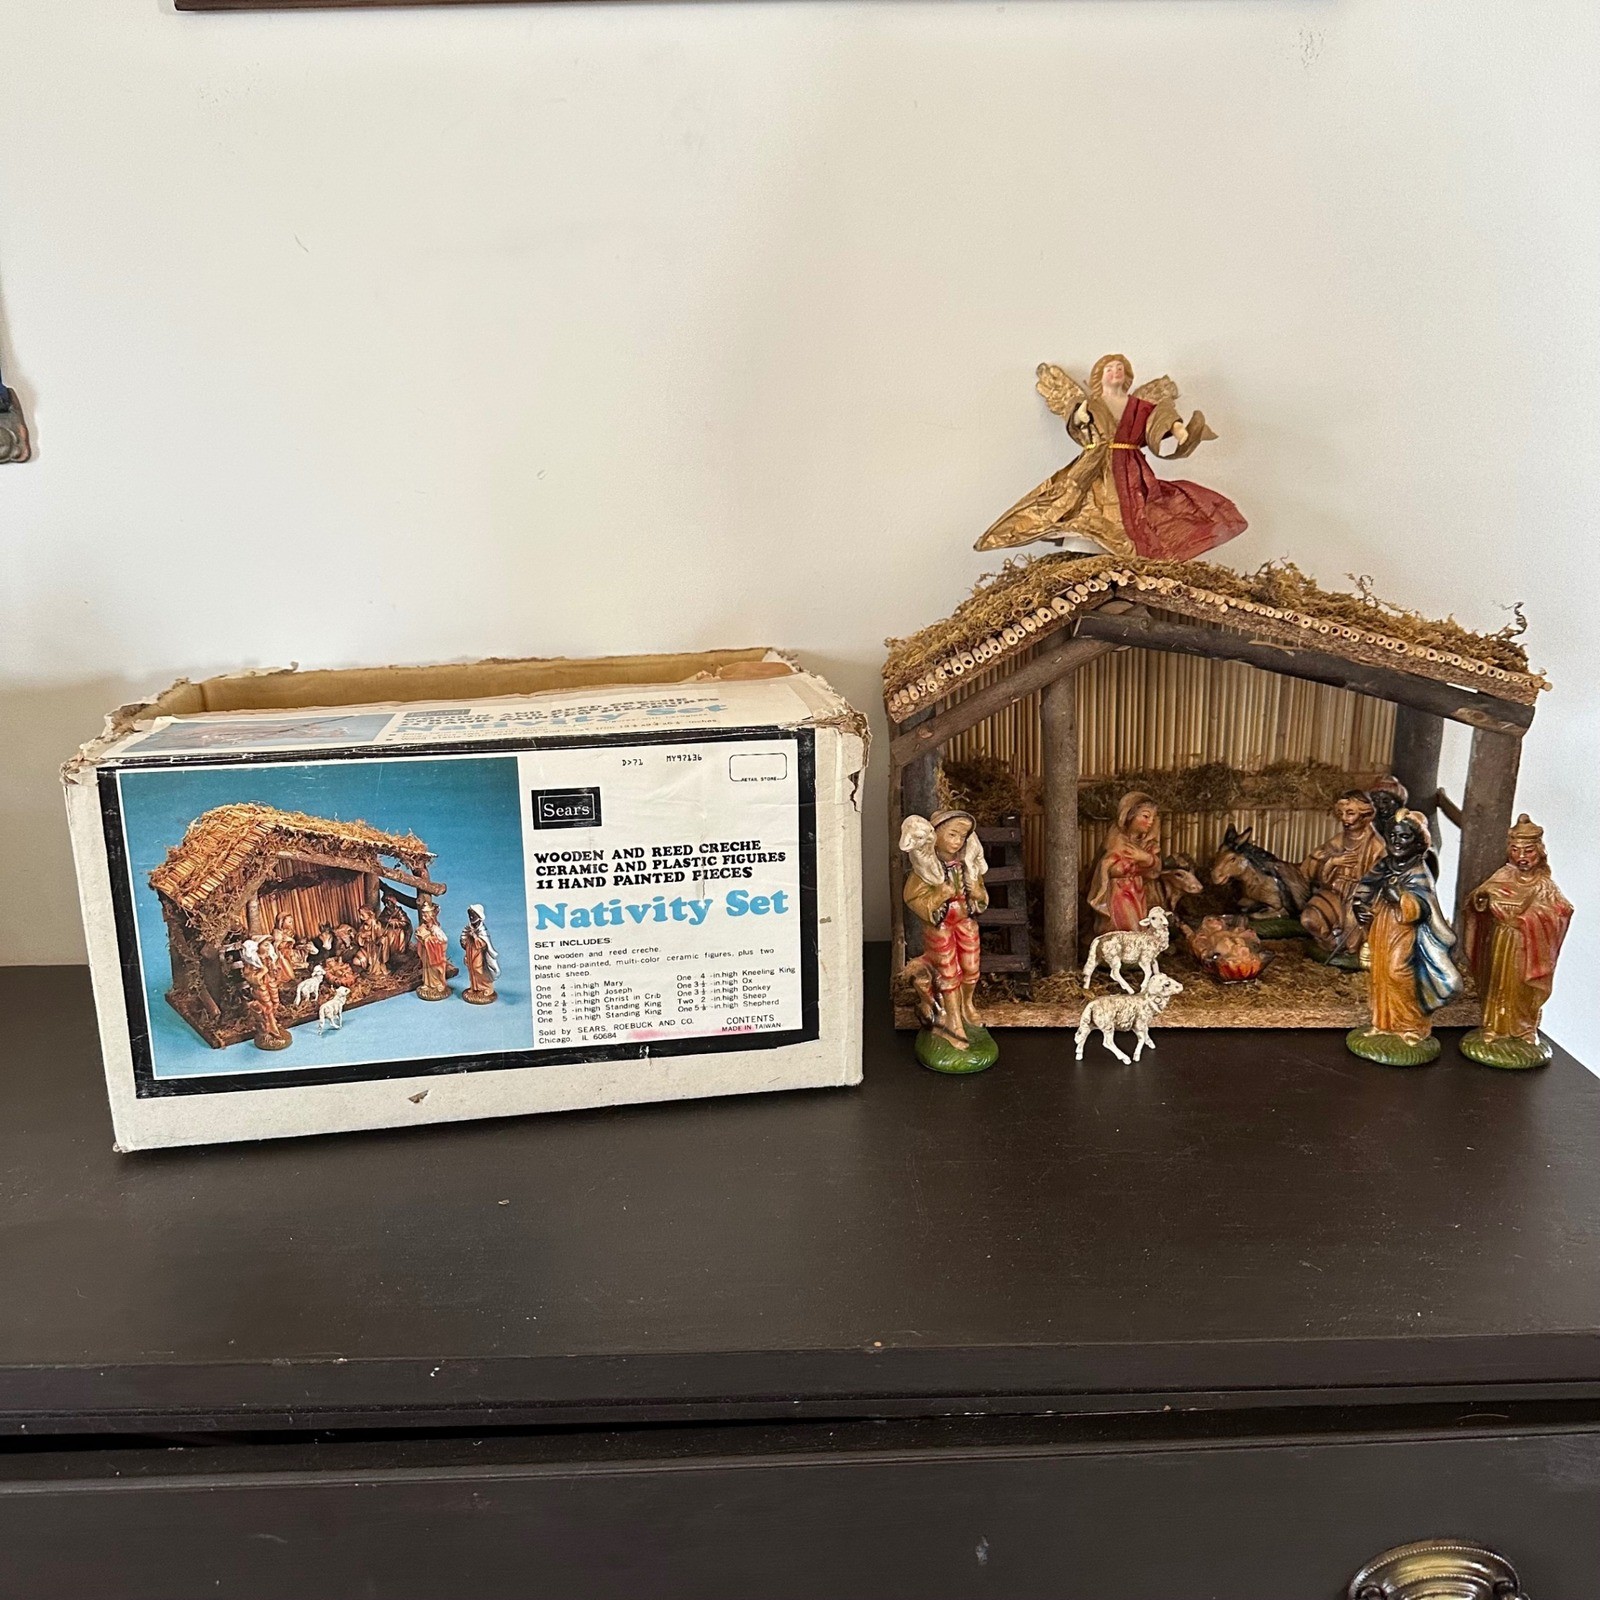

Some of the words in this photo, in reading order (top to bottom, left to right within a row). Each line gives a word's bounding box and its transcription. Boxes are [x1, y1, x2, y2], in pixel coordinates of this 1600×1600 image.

[646, 704, 728, 716] Set
[543, 803, 591, 818] Sears
[534, 850, 604, 864] WOODEN
[612, 848, 645, 860] AND
[652, 845, 693, 857] REED
[699, 840, 761, 854] CRECHE
[536, 863, 608, 877] CERAMIC
[614, 861, 647, 873] AND
[652, 856, 717, 870] PLASTIC
[722, 852, 786, 865] FIGURES
[536, 880, 556, 889] 11
[558, 876, 606, 889] HAND
[613, 872, 685, 886] PAINTED
[692, 867, 753, 881] PIECES
[534, 896, 713, 930] Nativity
[726, 890, 789, 917] Set
[559, 937, 612, 947] INCLUDES:
[554, 951, 584, 960] wooden
[632, 946, 661, 954] creche.
[616, 956, 660, 966] multi-color
[738, 949, 754, 957] plus
[535, 972, 560, 980] plastic
[603, 995, 629, 1003] Christ
[742, 999, 780, 1007] Shepherd
[605, 1003, 640, 1011] Standing
[605, 1010, 640, 1019] Standing
[644, 1008, 662, 1016] King
[613, 1021, 653, 1030] ROEBUCK
[658, 1019, 676, 1027] AND
[726, 1014, 775, 1025] CONTENTS
[755, 1022, 781, 1030] TAIWAN
[593, 1032, 617, 1040] 60684
